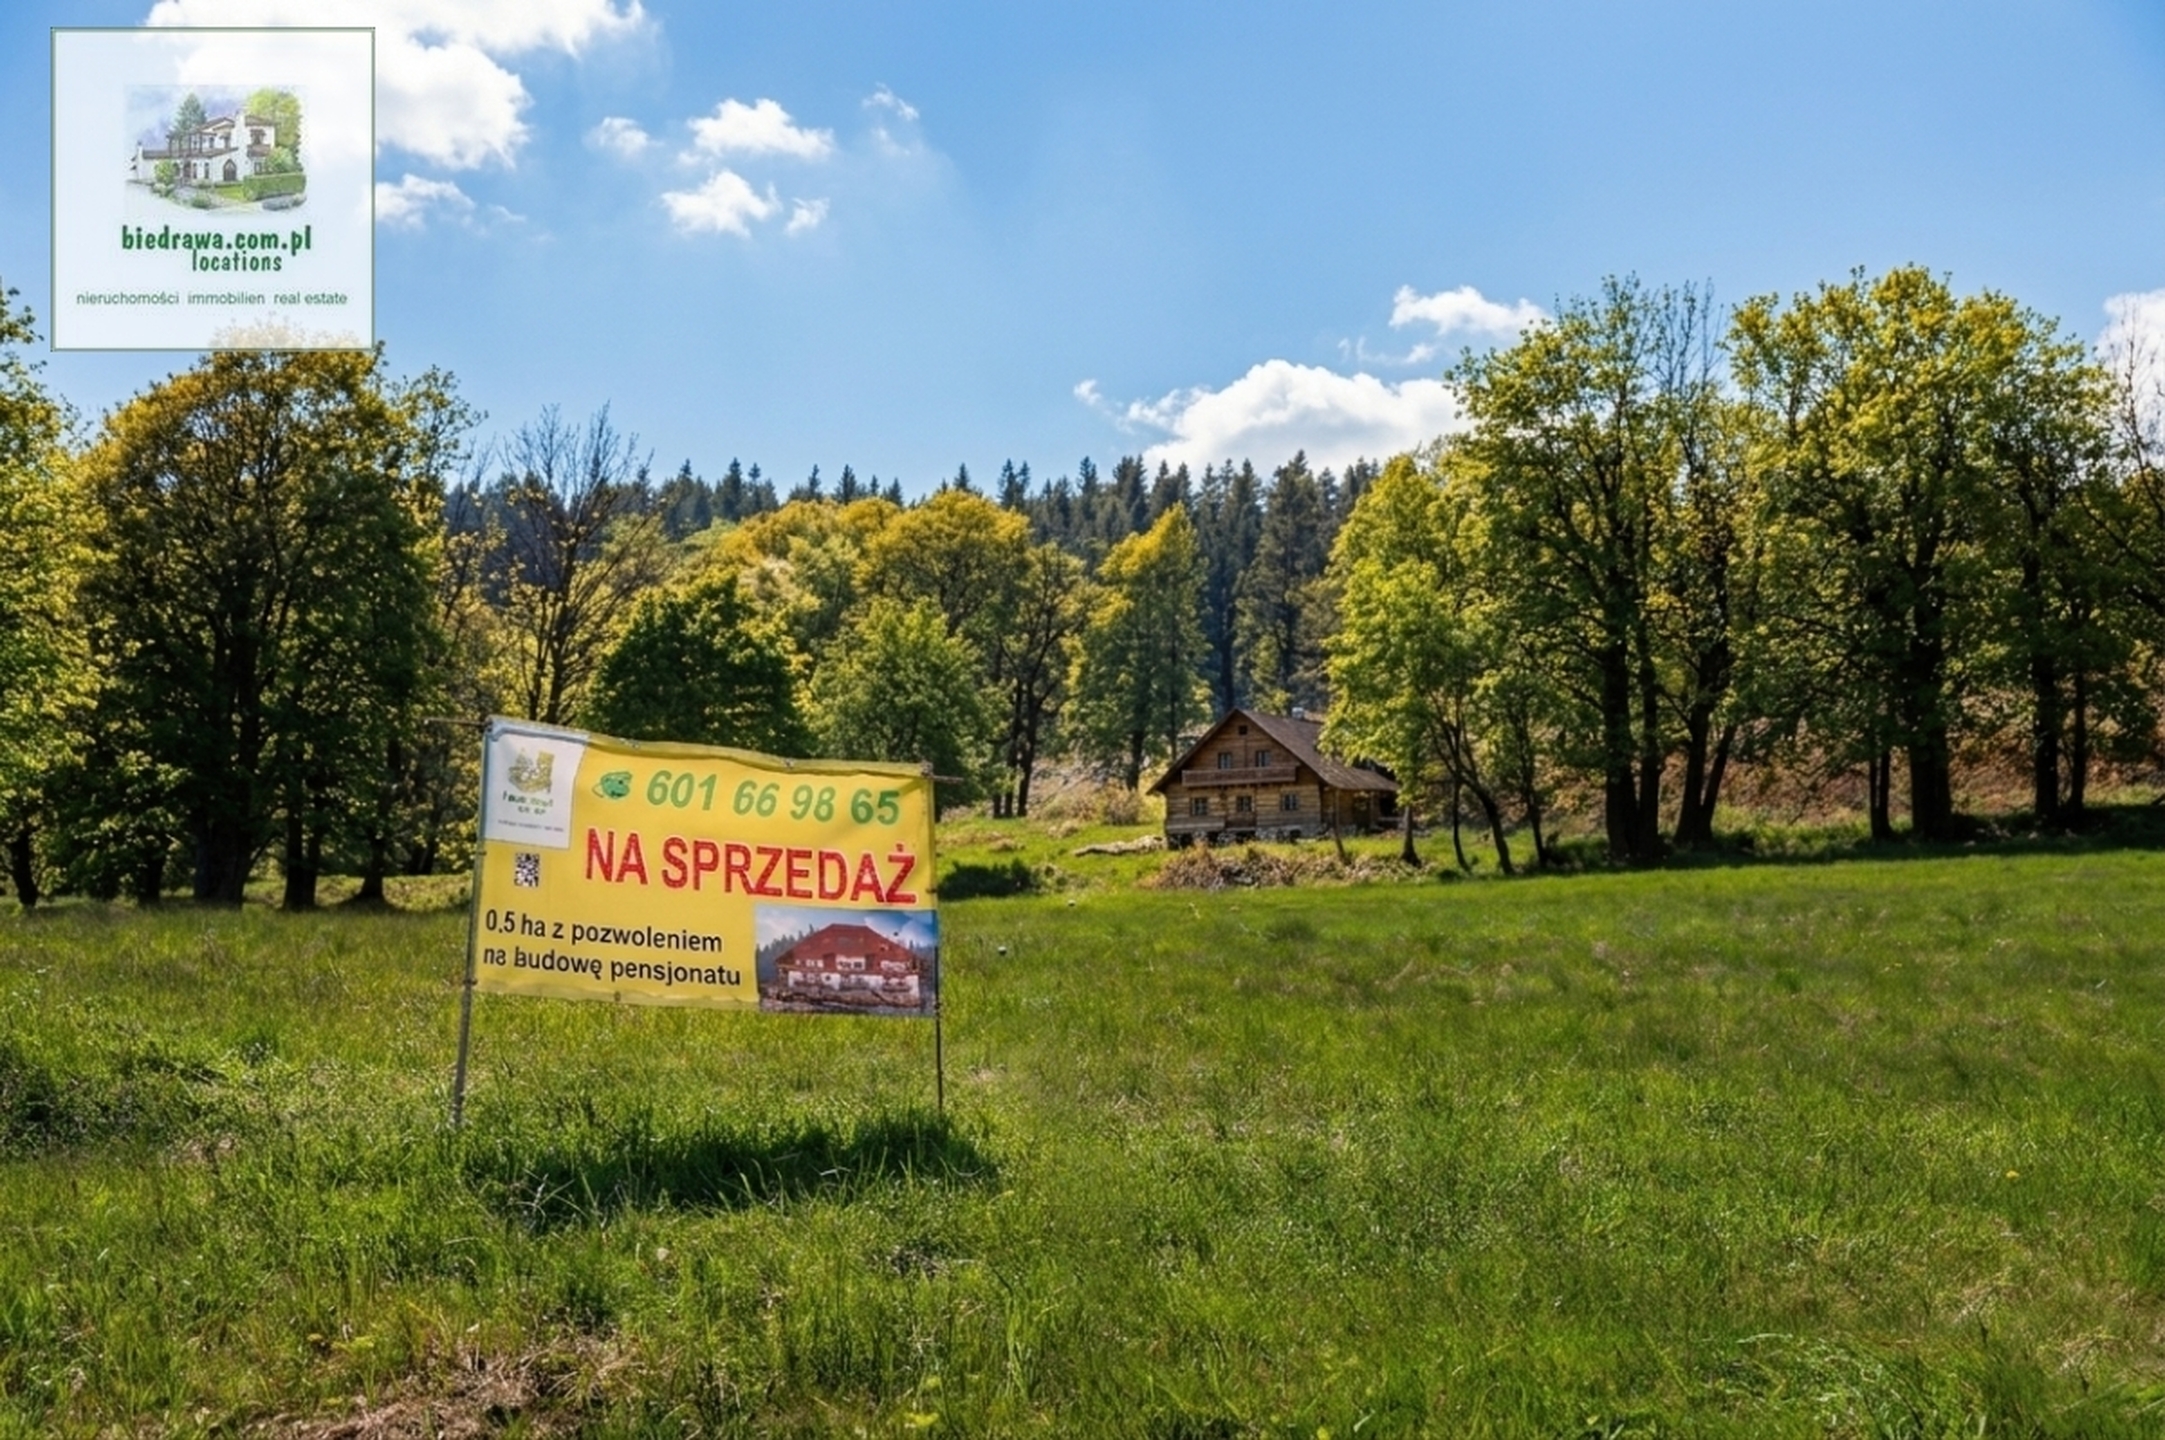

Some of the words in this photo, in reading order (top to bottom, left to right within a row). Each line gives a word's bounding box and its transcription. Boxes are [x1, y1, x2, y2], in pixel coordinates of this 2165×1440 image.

[646, 770, 718, 812] 601
[733, 780, 781, 818] 66
[789, 784, 836, 823] 98
[850, 788, 901, 825] 65
[586, 828, 649, 886] NA
[661, 836, 918, 905] SPRZEDAŻ
[520, 912, 547, 938] ha
[551, 922, 565, 940] z
[571, 923, 723, 953] pozwoleniem
[482, 947, 507, 967] na
[513, 945, 603, 981] budowę
[610, 960, 742, 987] pensjonatu
